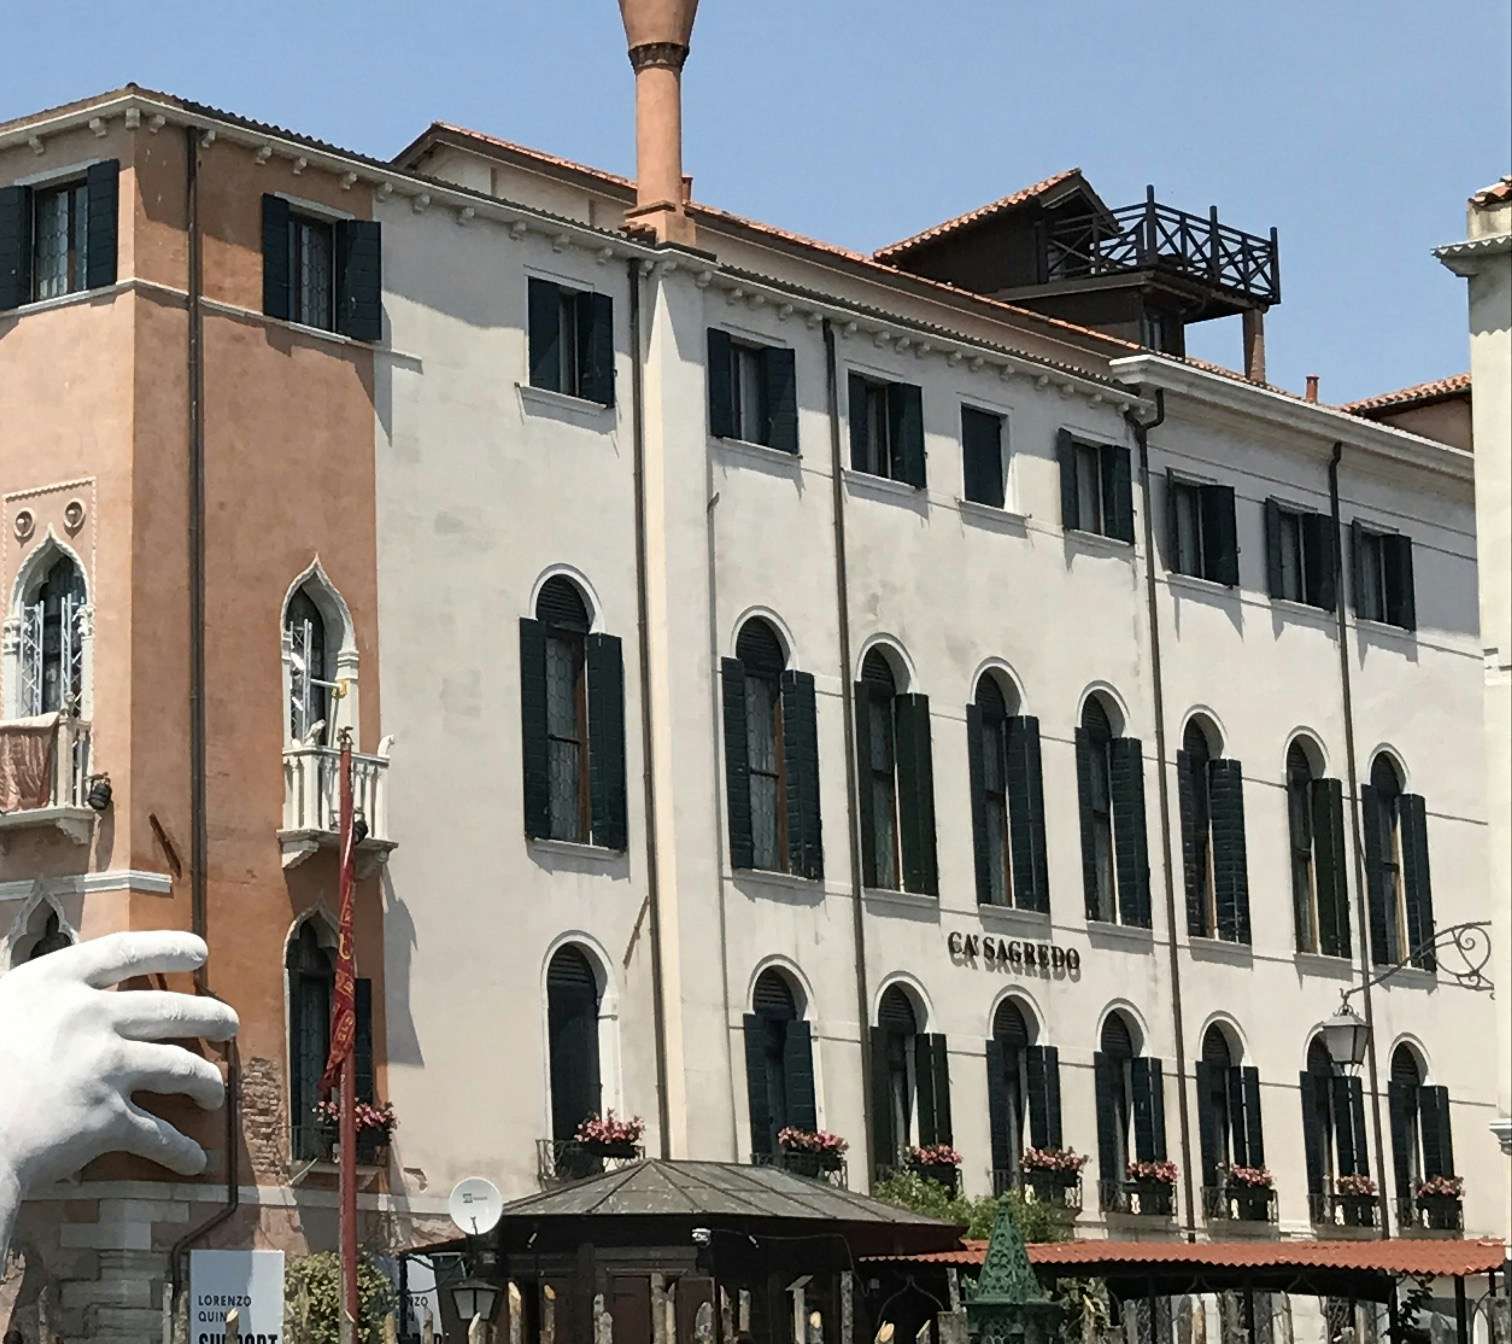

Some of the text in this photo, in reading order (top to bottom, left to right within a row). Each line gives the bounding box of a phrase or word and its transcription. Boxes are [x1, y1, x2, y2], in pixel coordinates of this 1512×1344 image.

[983, 936, 1080, 970] SAGREDO
[198, 1295, 252, 1307] LORENZO
[198, 1310, 228, 1323] QUIN
